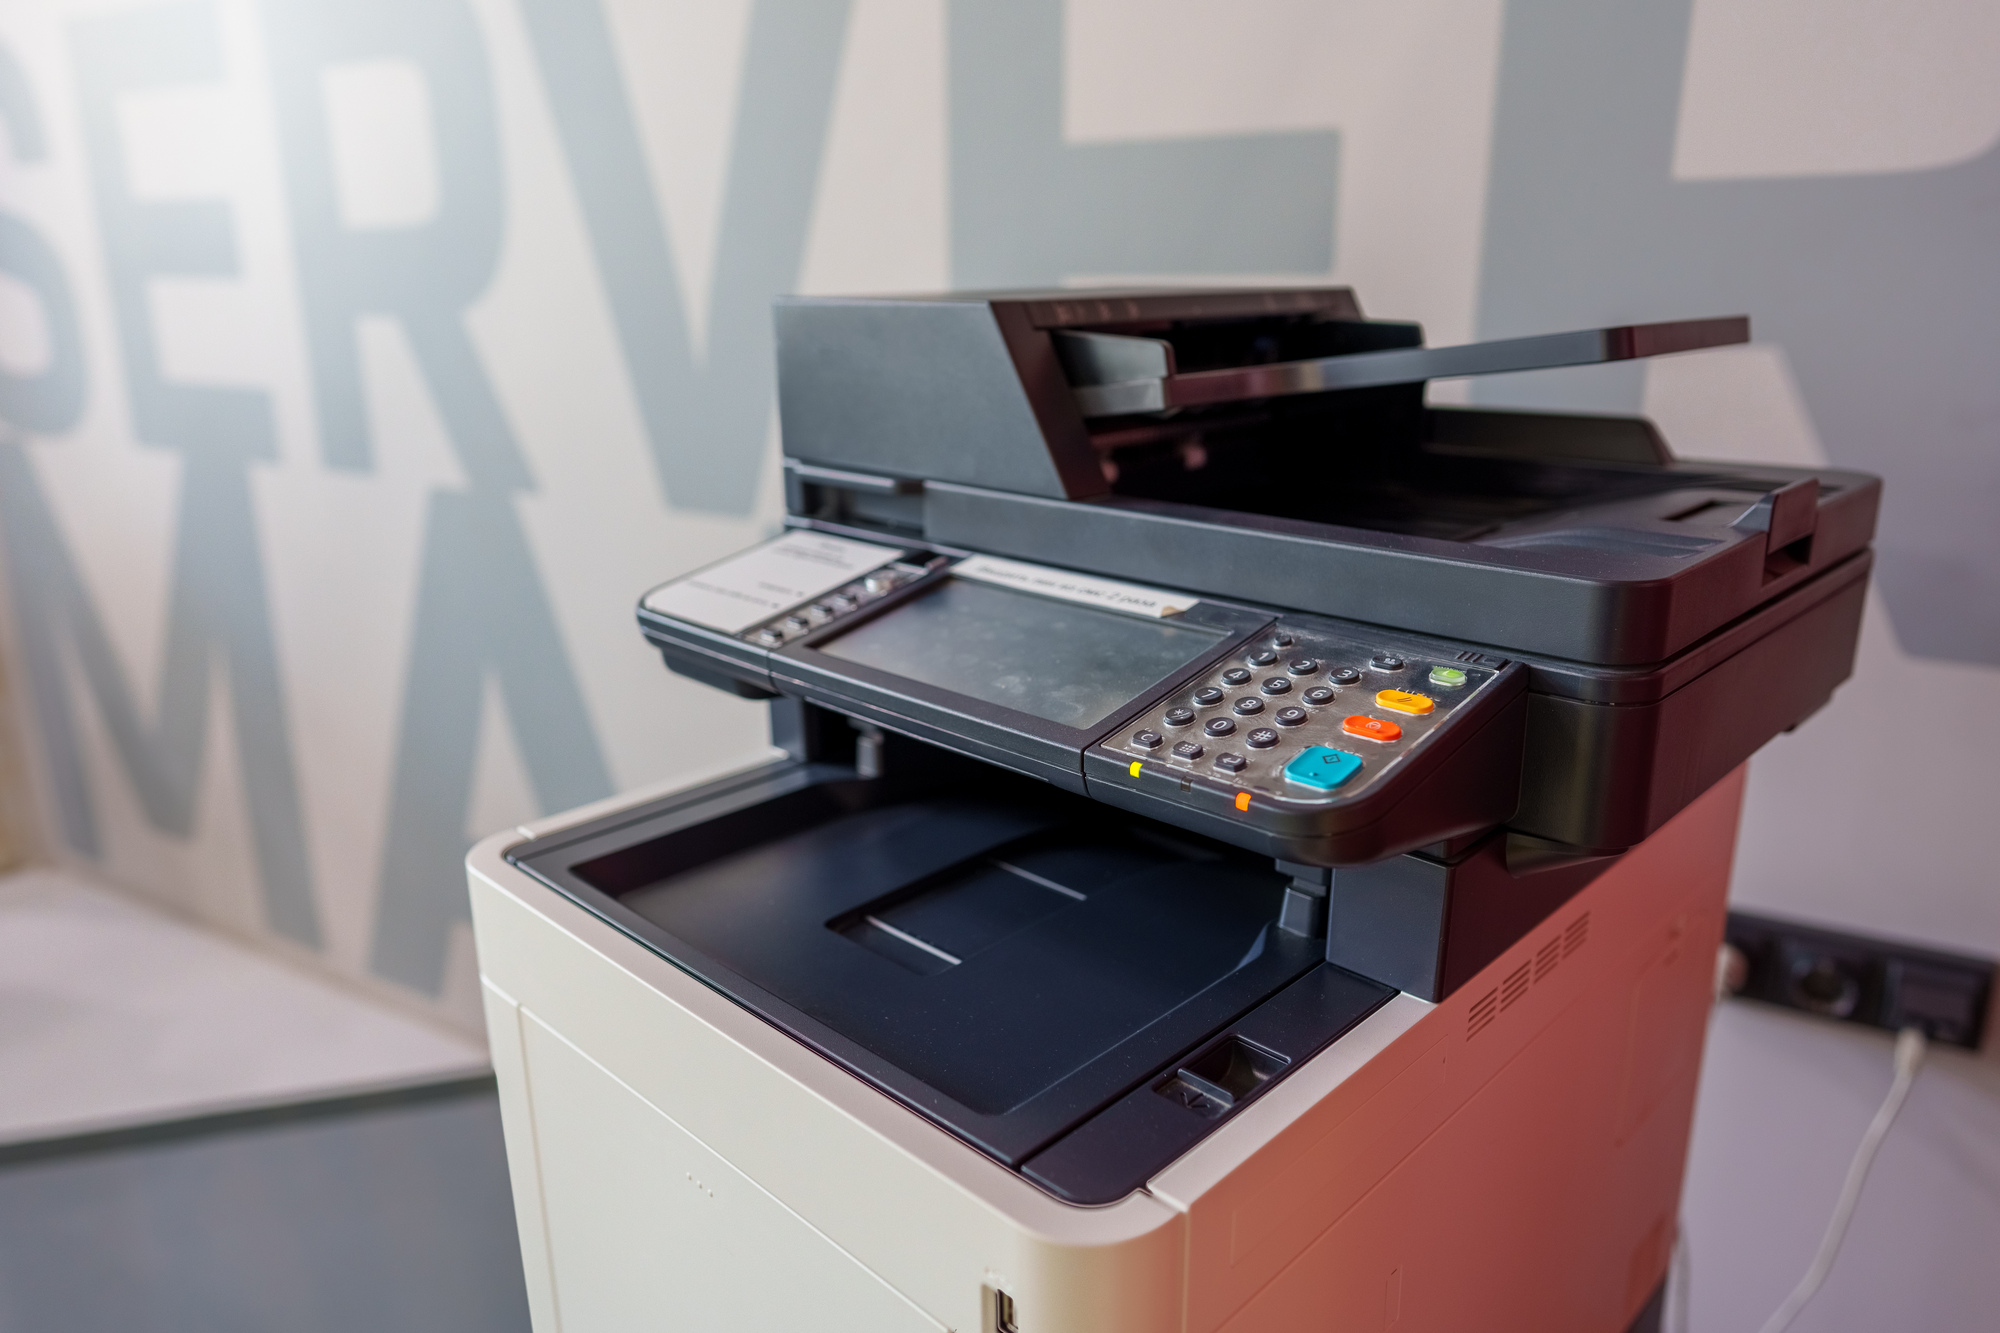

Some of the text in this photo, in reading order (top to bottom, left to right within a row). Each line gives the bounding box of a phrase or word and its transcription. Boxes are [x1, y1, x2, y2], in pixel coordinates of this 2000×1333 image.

[1258, 652, 1270, 660] 1
[1295, 660, 1311, 669] 2
[1229, 670, 1244, 679] 4
[1337, 669, 1353, 678] 3
[1269, 679, 1285, 688] 5
[1201, 689, 1218, 698] 7
[1311, 689, 1327, 698] 6
[1241, 699, 1257, 708] 8
[1283, 709, 1298, 719] 9
[1212, 720, 1227, 729] 0
[1141, 733, 1154, 741] C
